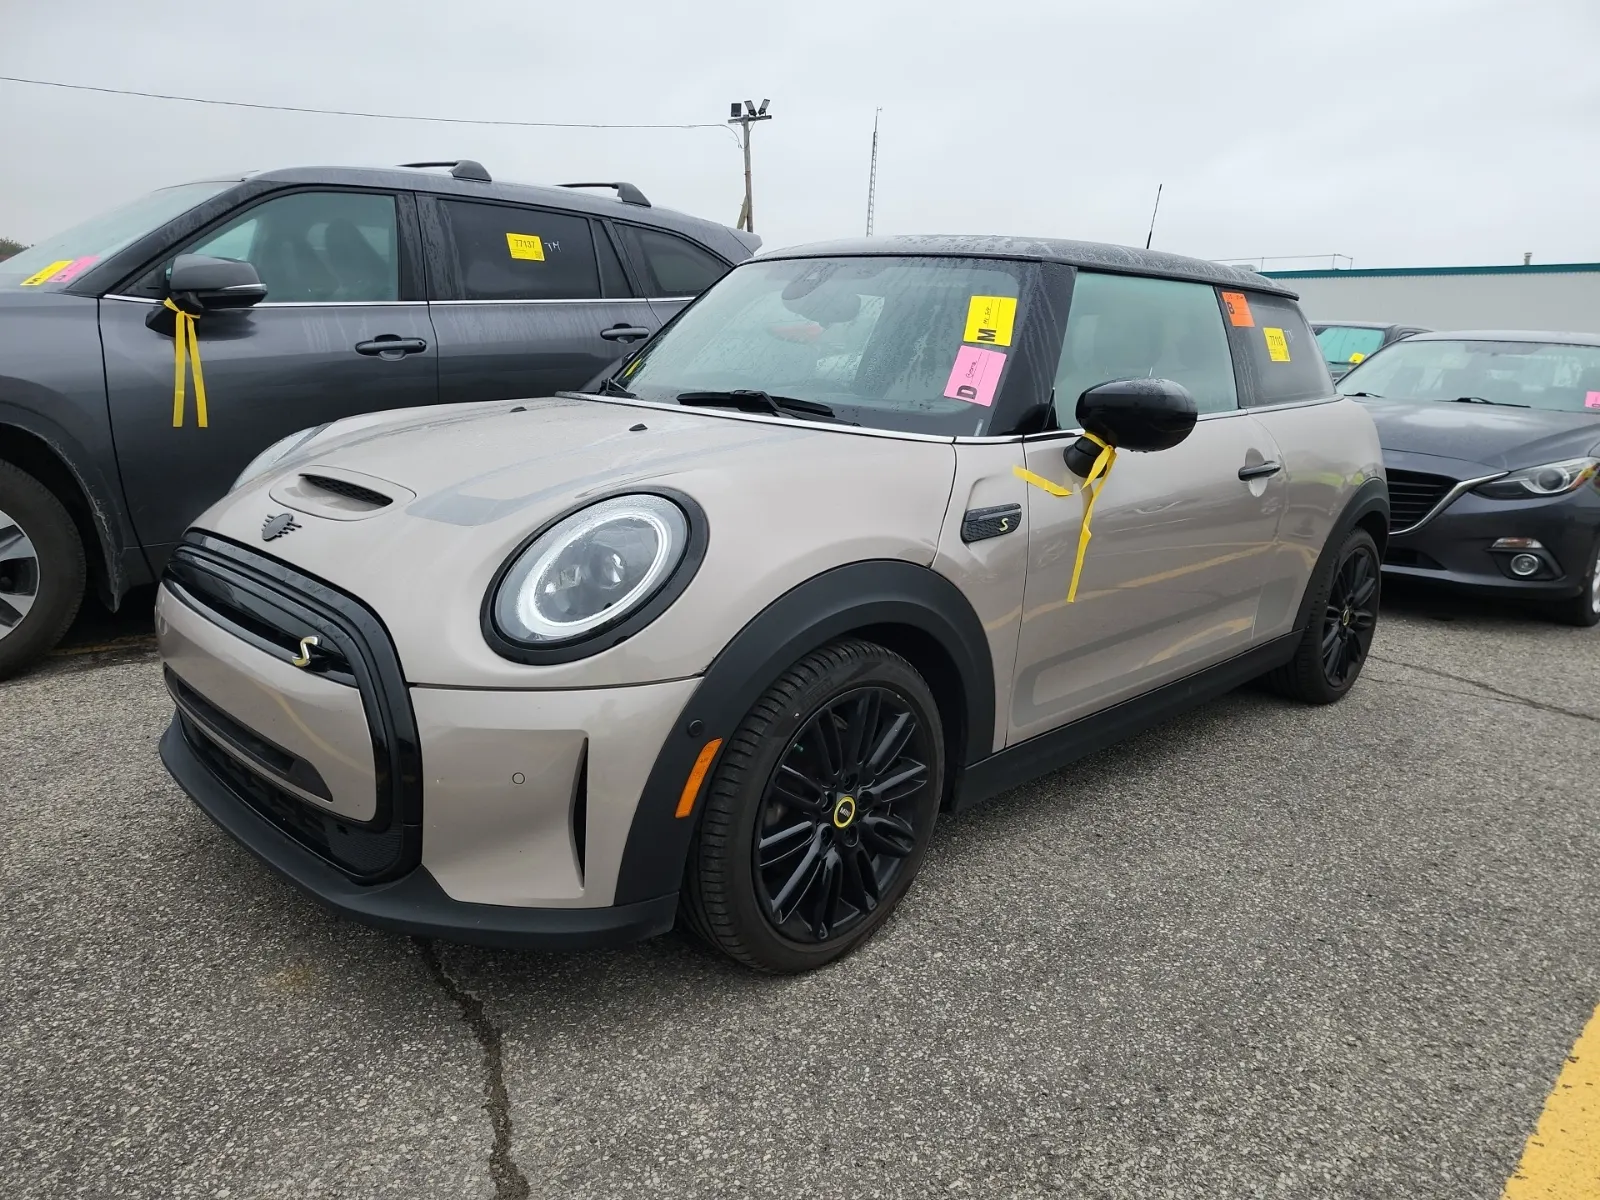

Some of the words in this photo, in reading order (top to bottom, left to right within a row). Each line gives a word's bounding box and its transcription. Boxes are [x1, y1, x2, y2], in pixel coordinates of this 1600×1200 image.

[513, 238, 536, 249] 77137
[1226, 301, 1235, 315] B
[976, 328, 997, 342] M
[956, 384, 978, 400] D
[999, 517, 1009, 532] S
[291, 635, 318, 667] S
